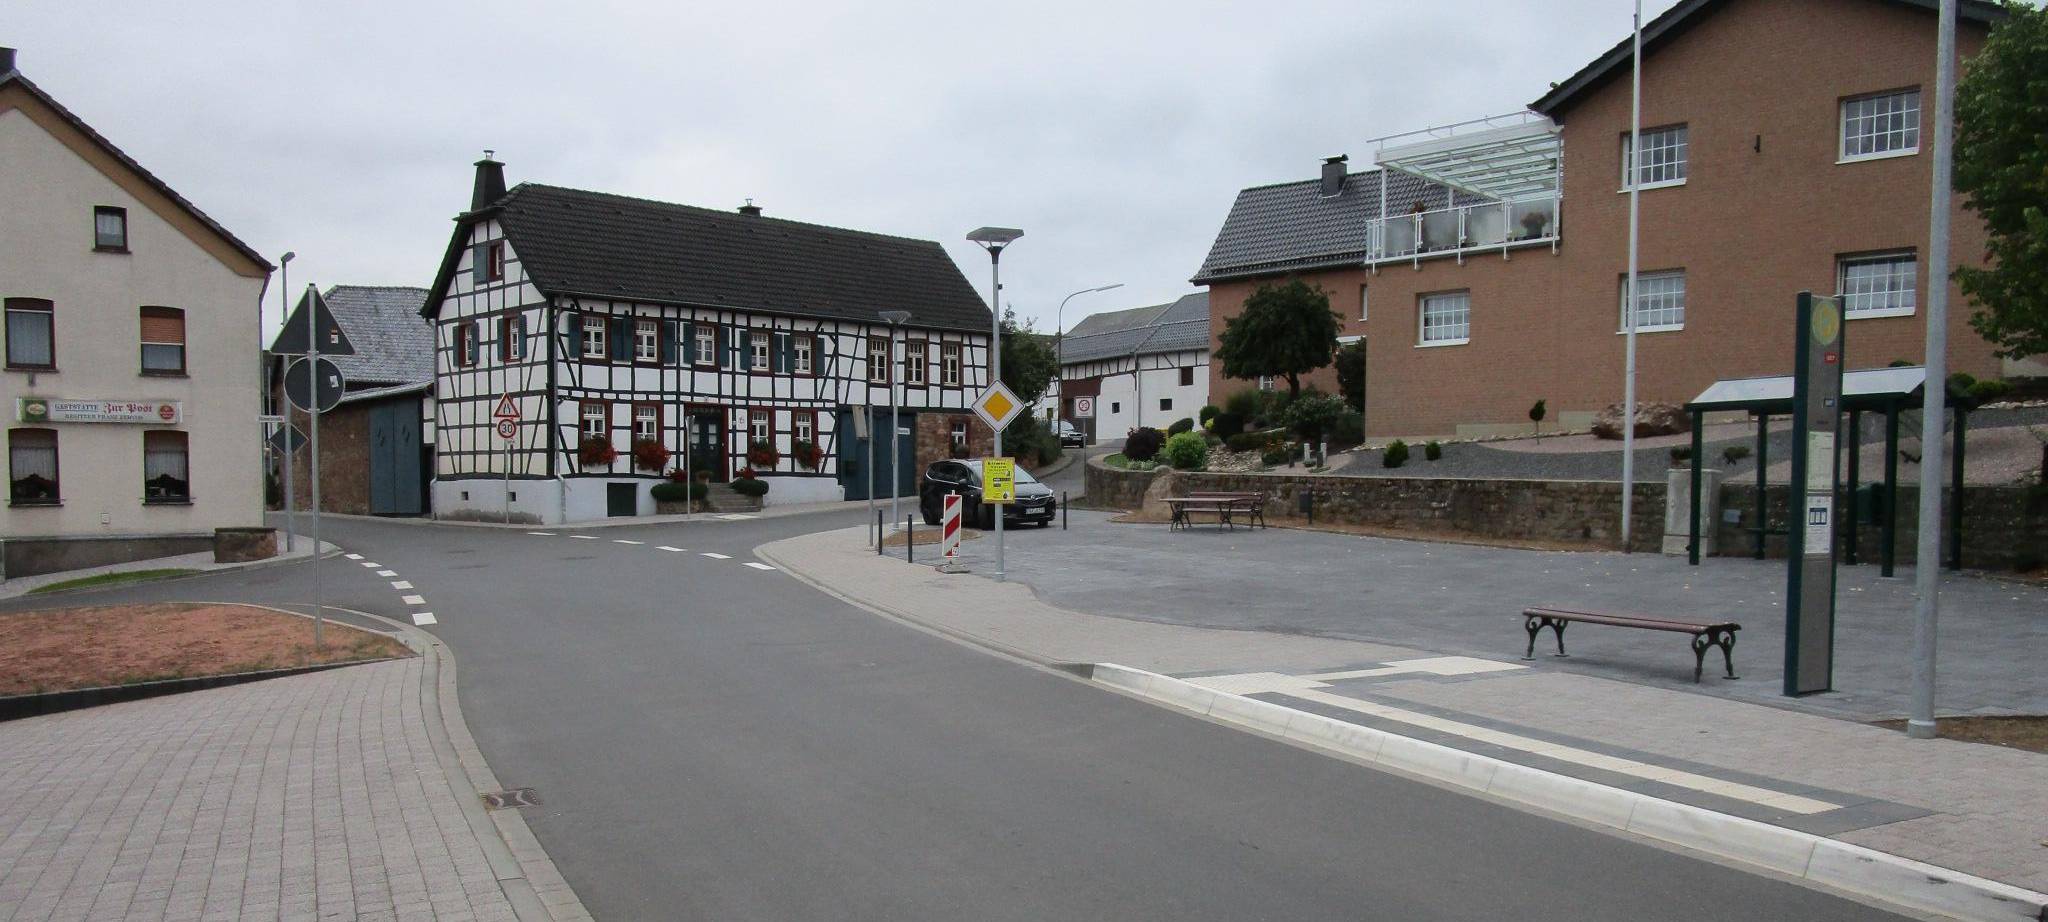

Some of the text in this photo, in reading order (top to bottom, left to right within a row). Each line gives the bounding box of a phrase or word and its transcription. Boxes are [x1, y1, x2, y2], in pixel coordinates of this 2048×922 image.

[105, 403, 123, 414] Zur
[127, 403, 153, 414] Post
[502, 424, 512, 433] 30
